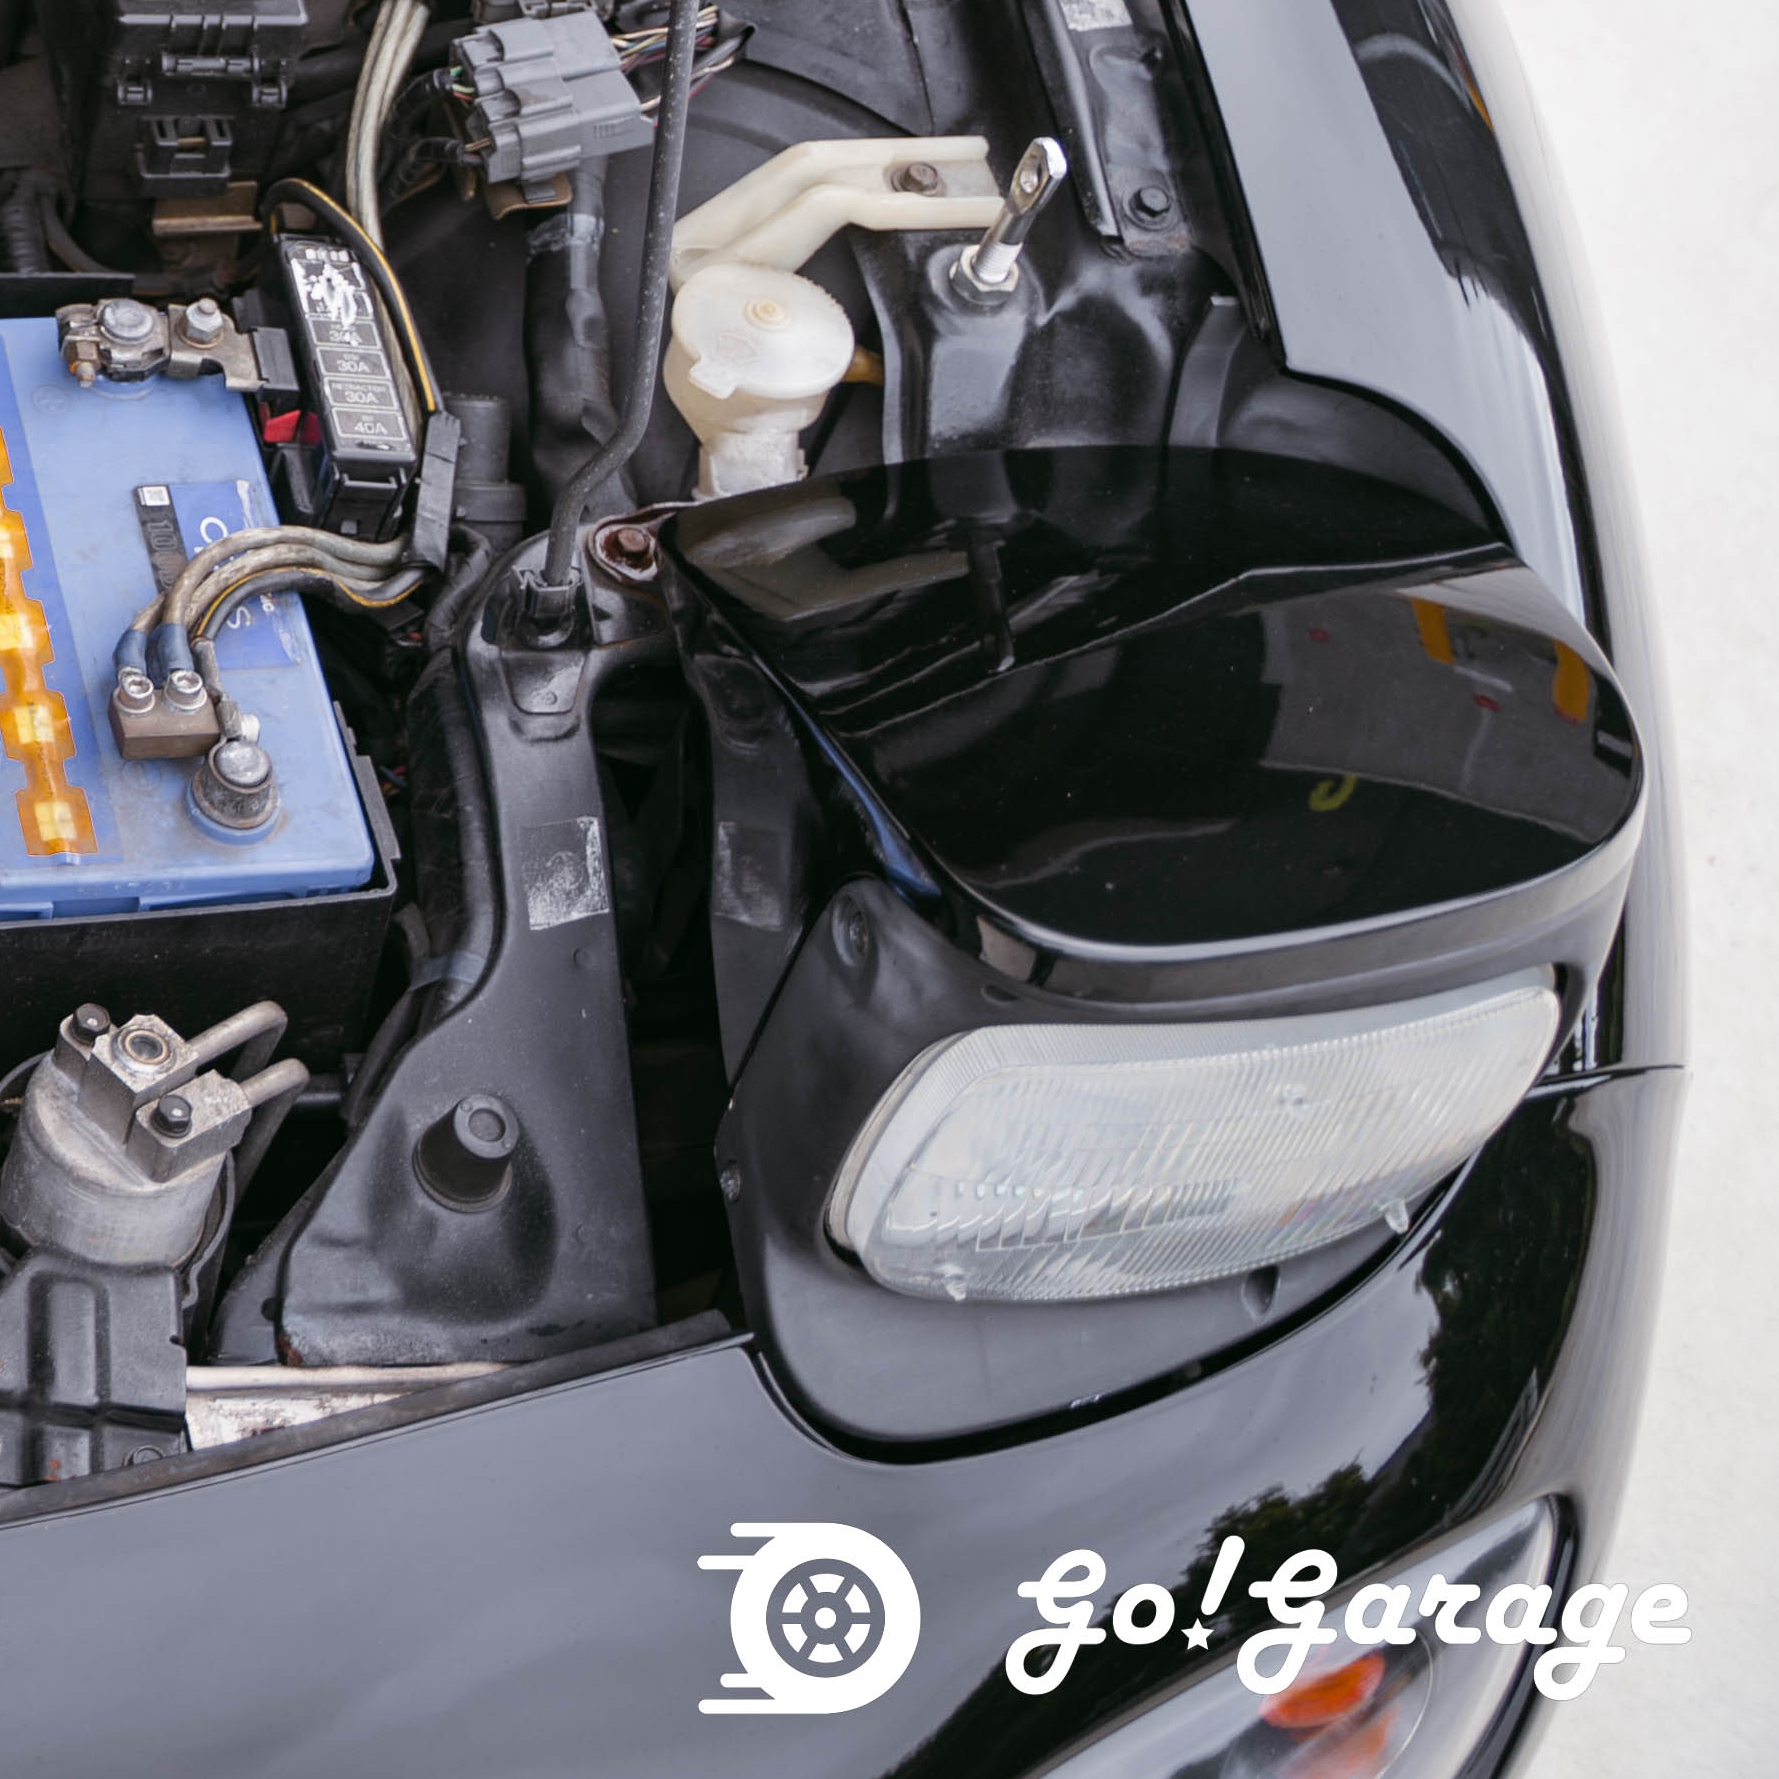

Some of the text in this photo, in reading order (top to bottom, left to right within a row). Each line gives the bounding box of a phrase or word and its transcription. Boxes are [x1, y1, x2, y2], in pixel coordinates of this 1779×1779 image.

[337, 359, 370, 373] 30A
[345, 391, 379, 404] 30A
[354, 420, 388, 435] 40A
